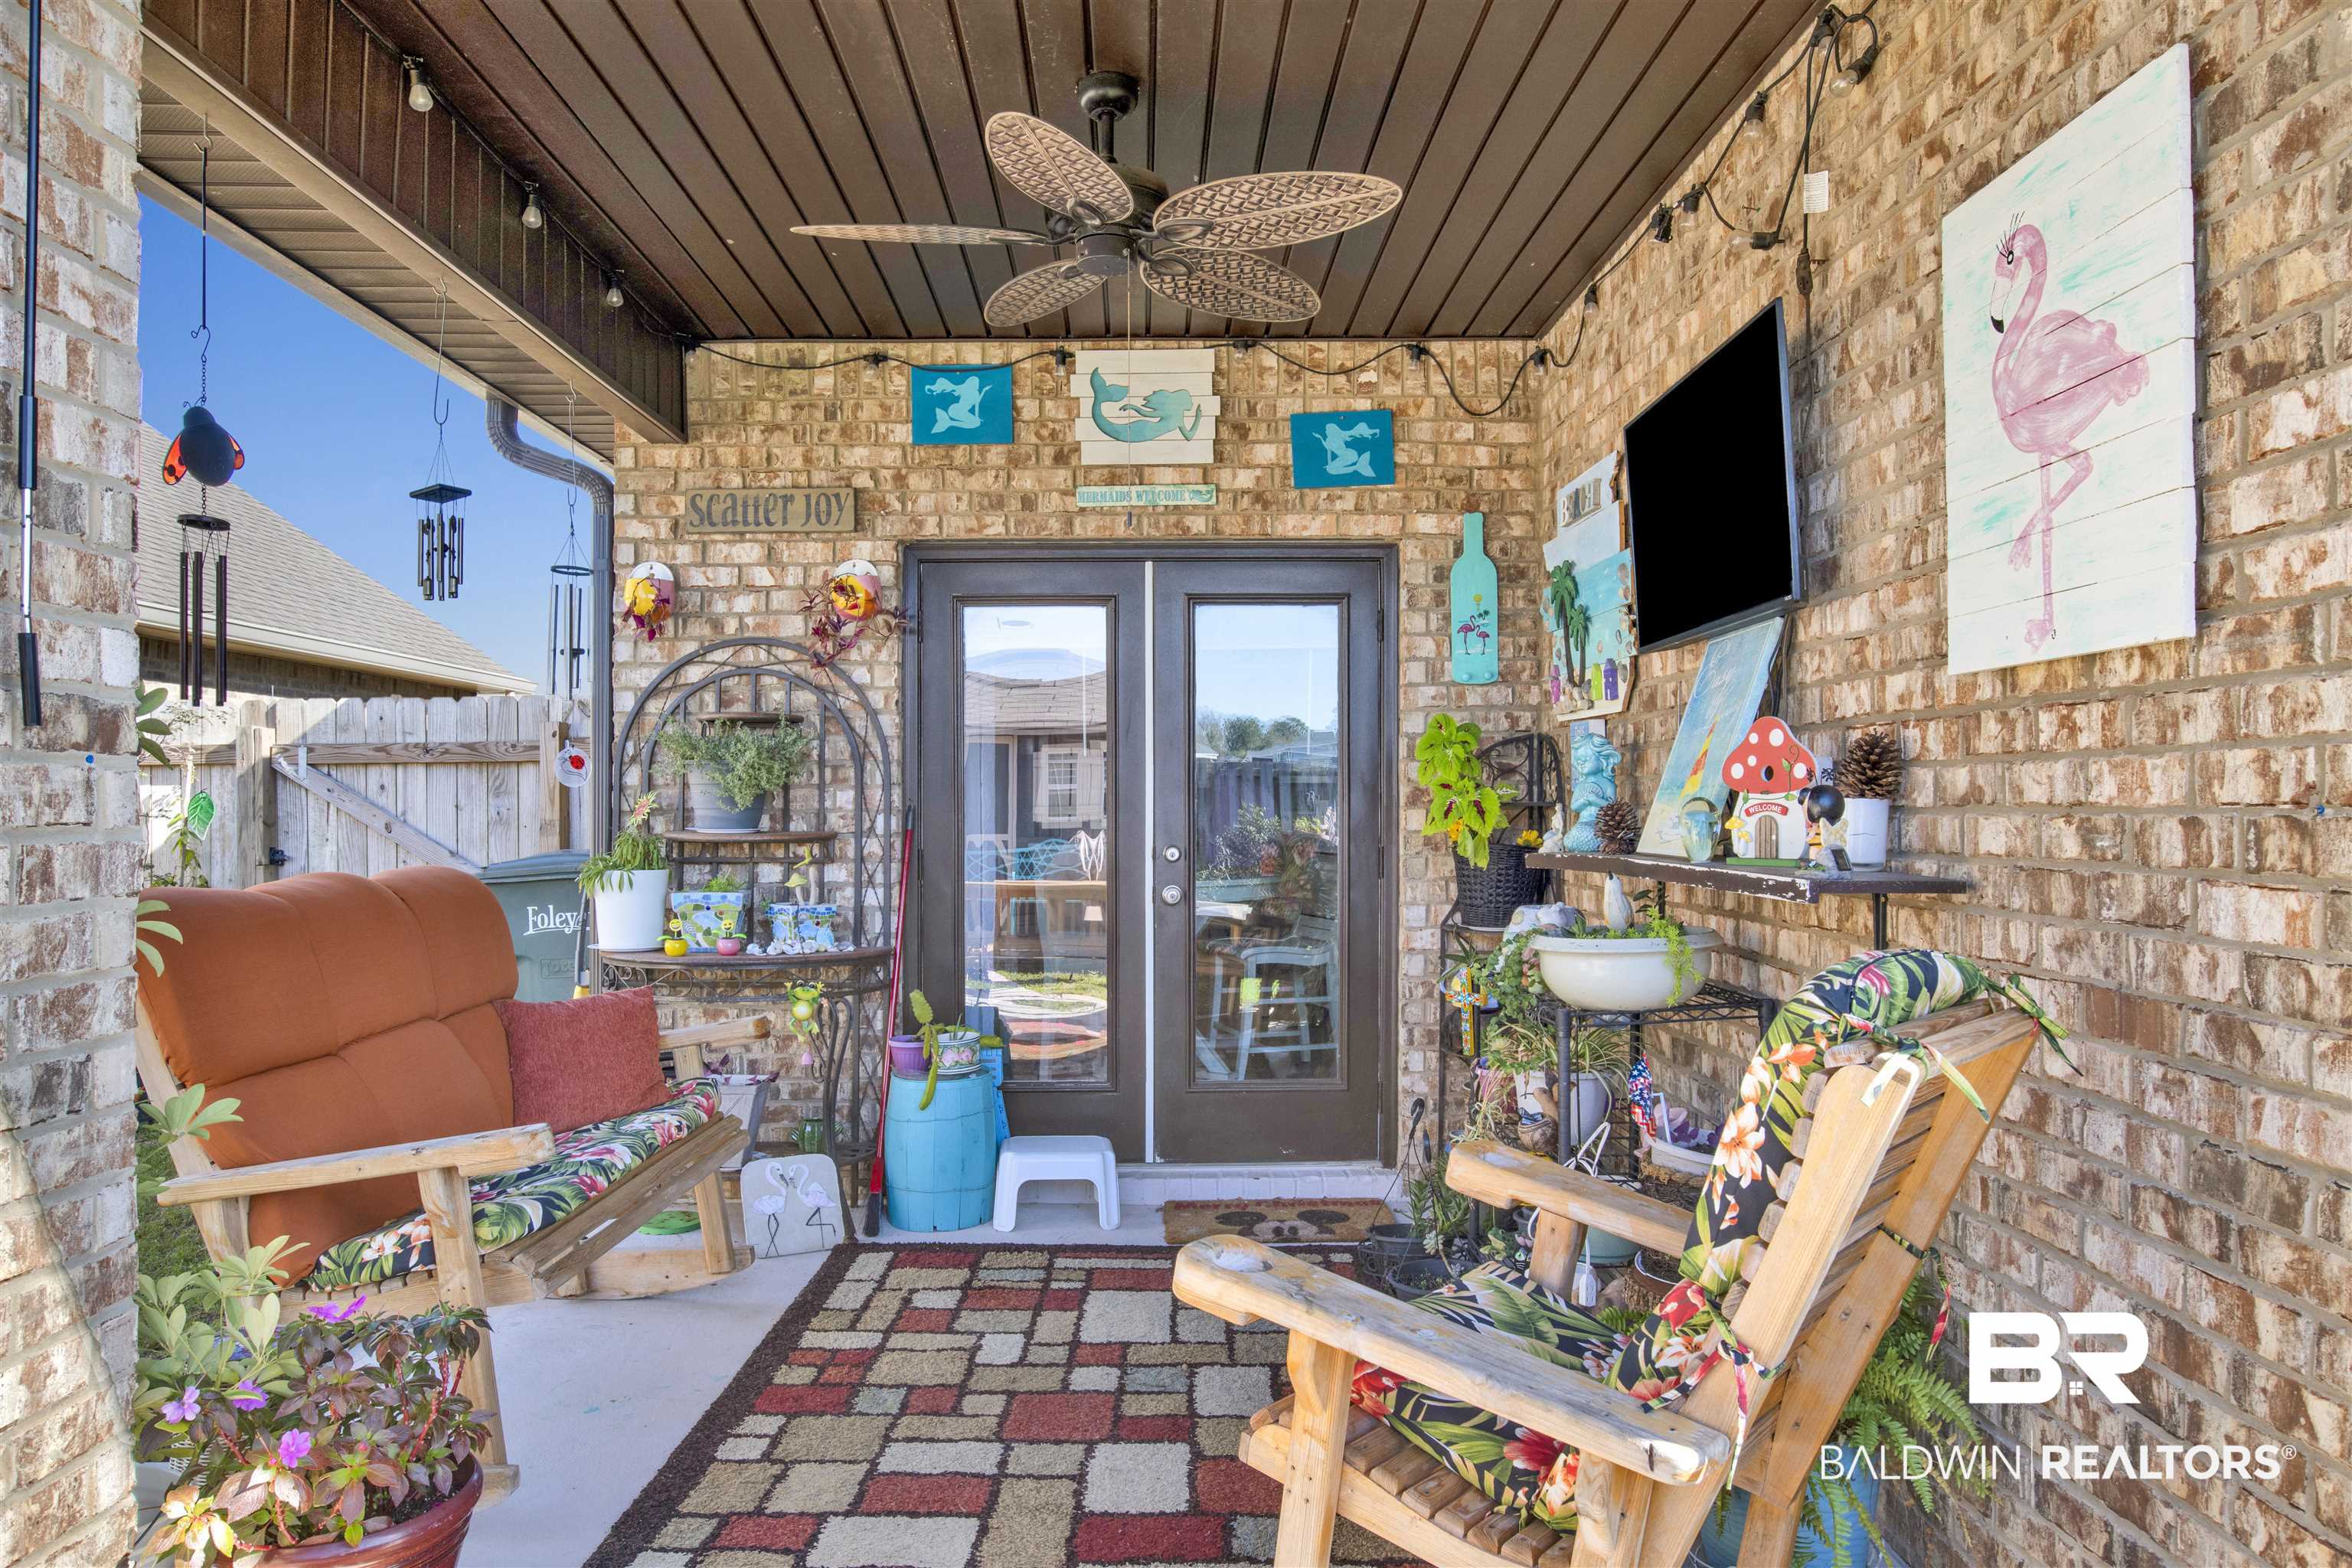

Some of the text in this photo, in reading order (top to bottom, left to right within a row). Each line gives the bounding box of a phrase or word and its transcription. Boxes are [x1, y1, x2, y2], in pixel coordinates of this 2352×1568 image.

[1077, 489, 1185, 502] MERMAIDS WELCOME
[1749, 804, 1782, 813] WELCOME
[526, 905, 577, 934] Foley
